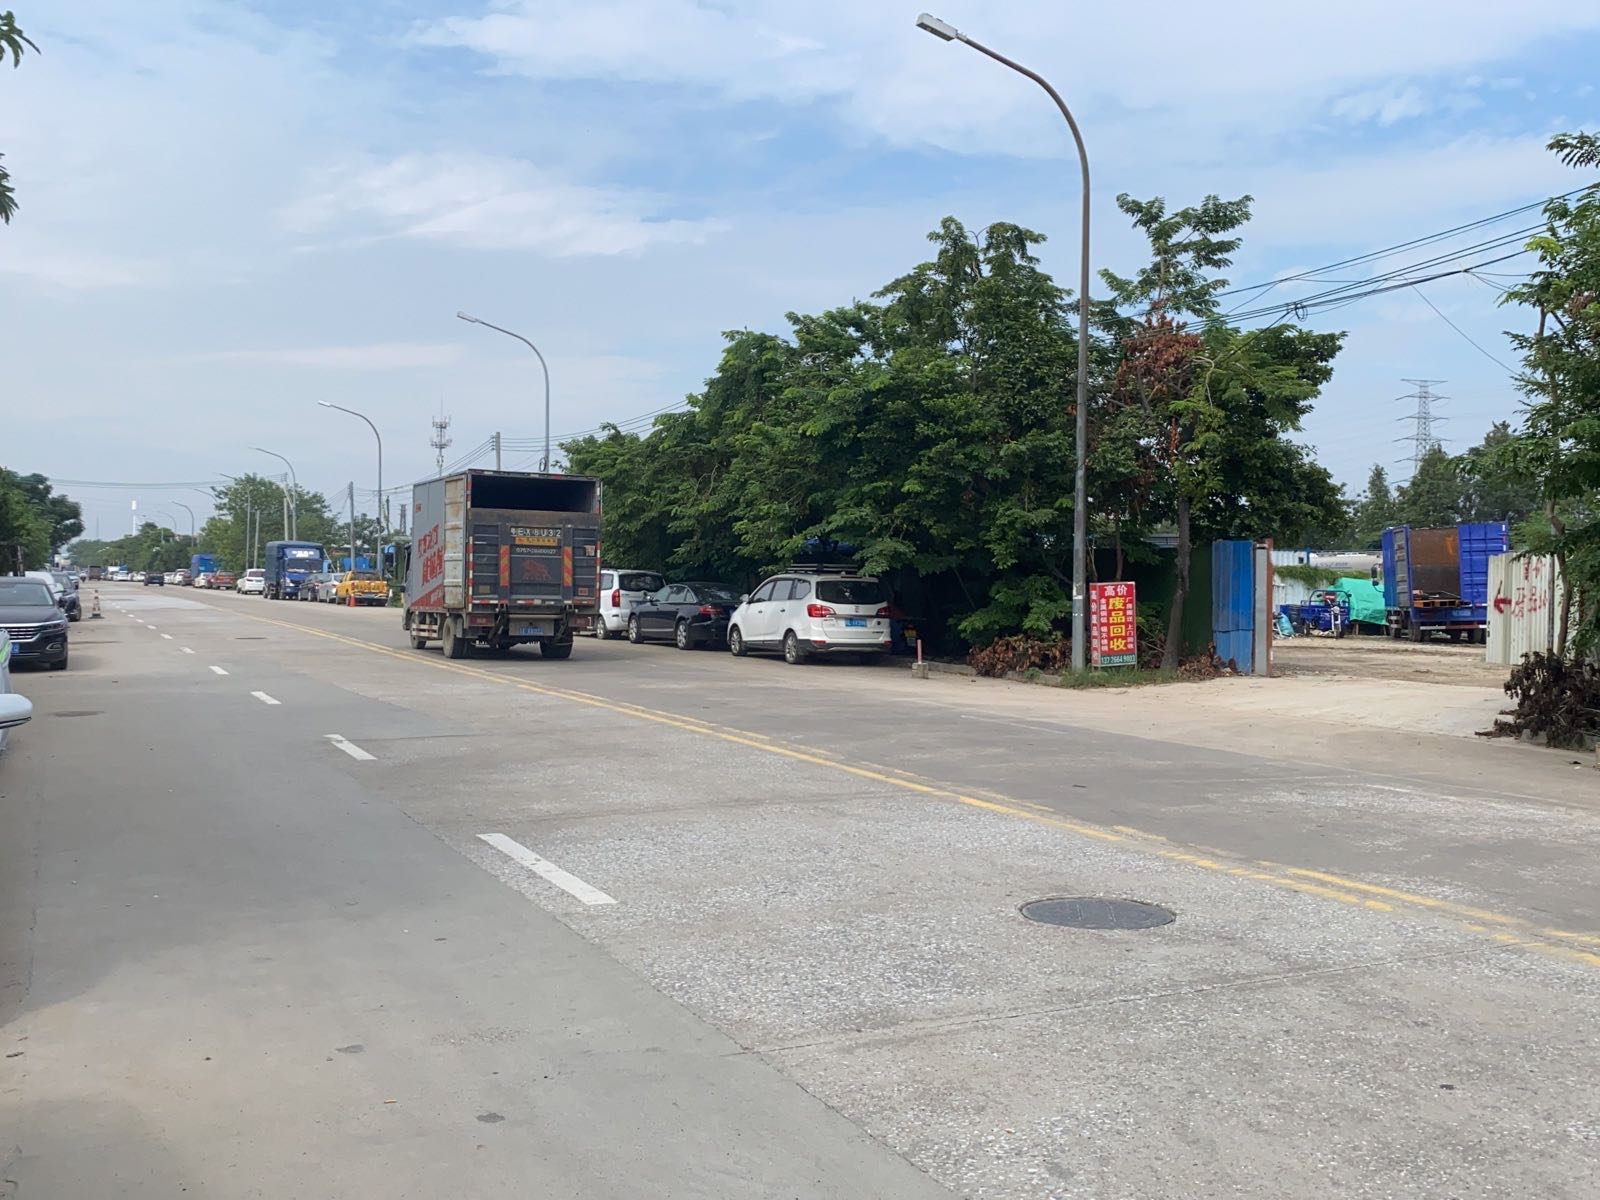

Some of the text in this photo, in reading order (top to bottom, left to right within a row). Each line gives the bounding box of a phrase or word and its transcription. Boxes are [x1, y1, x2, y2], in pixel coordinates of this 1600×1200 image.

[1104, 585, 1128, 596] 高价
[1108, 597, 1127, 651] 废品回收
